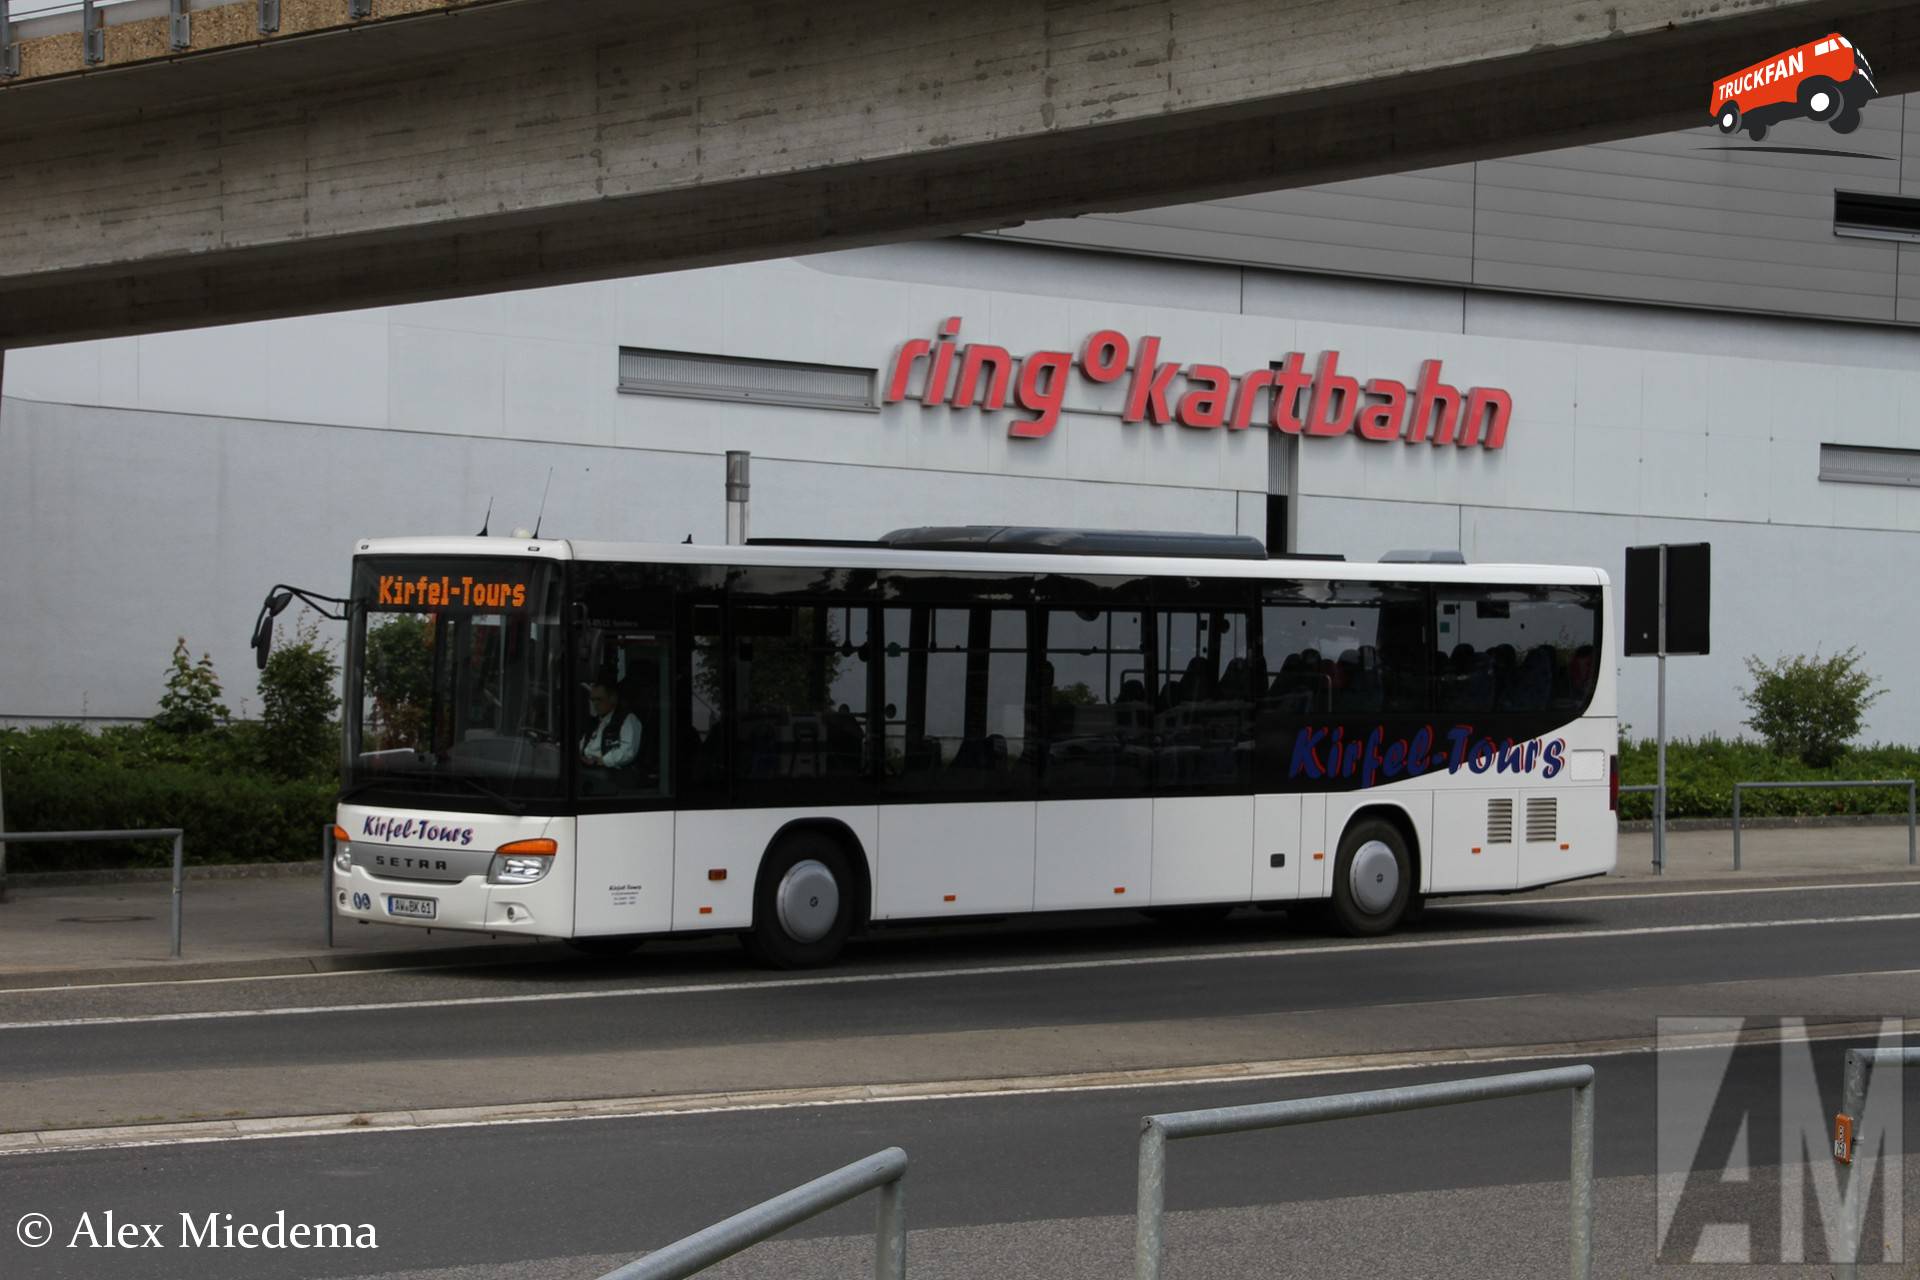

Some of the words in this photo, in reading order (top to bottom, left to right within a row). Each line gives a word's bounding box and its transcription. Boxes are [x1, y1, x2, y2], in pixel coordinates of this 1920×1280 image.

[379, 575, 526, 607] Kirfel-Tours
[1289, 724, 1566, 789] Kirfel-Tours
[363, 815, 474, 845] Kirfel-Tours
[376, 855, 447, 870] SETRA
